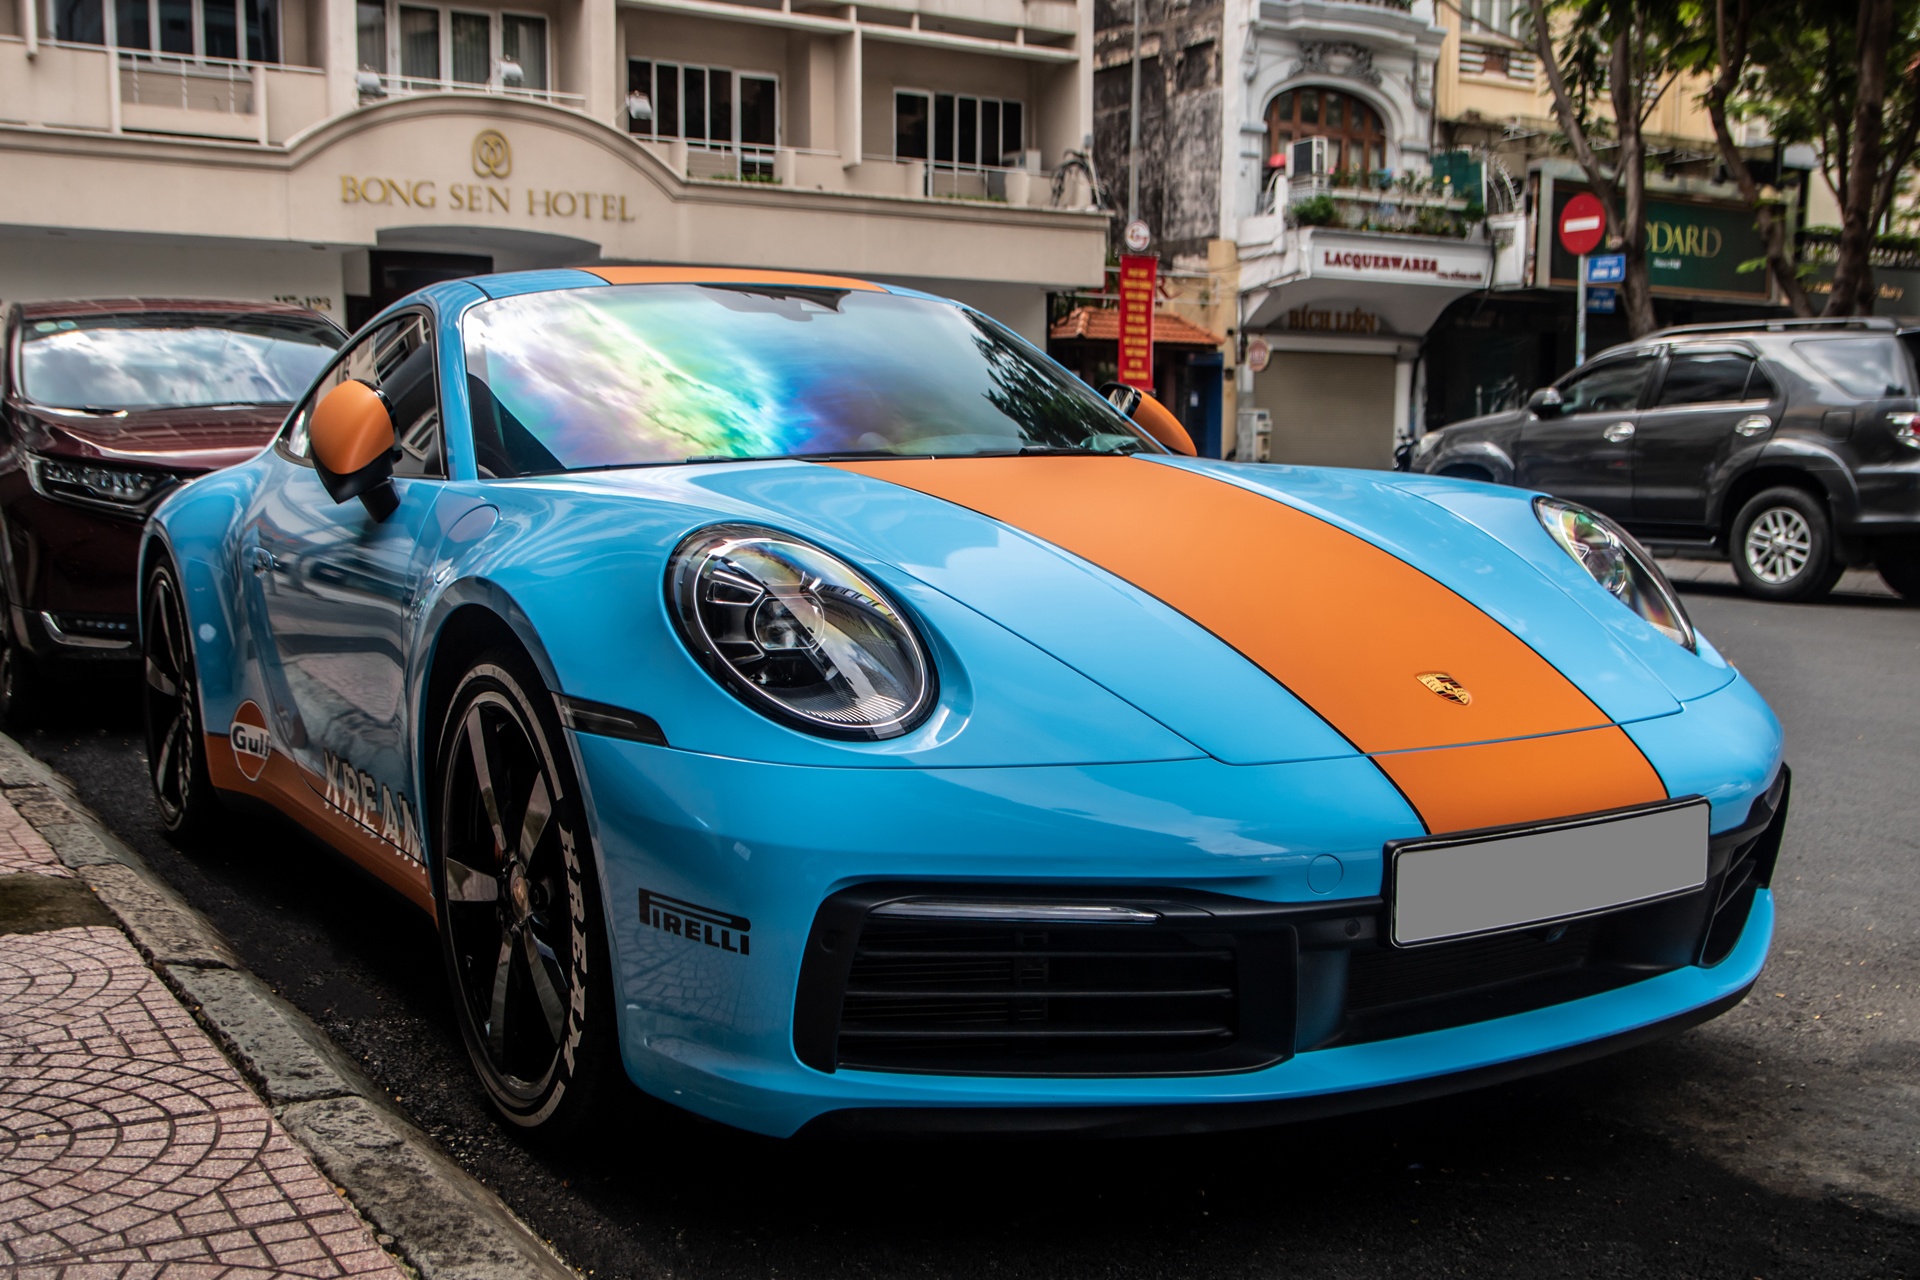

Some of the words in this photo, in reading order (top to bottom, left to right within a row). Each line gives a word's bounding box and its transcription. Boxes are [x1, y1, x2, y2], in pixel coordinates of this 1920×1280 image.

[339, 175, 437, 208] BONG
[448, 183, 511, 214] SEN
[526, 189, 637, 222] HOTEL
[232, 724, 271, 757] Gulf
[558, 822, 588, 1078] KREAM
[638, 887, 752, 956] PIRELLI
